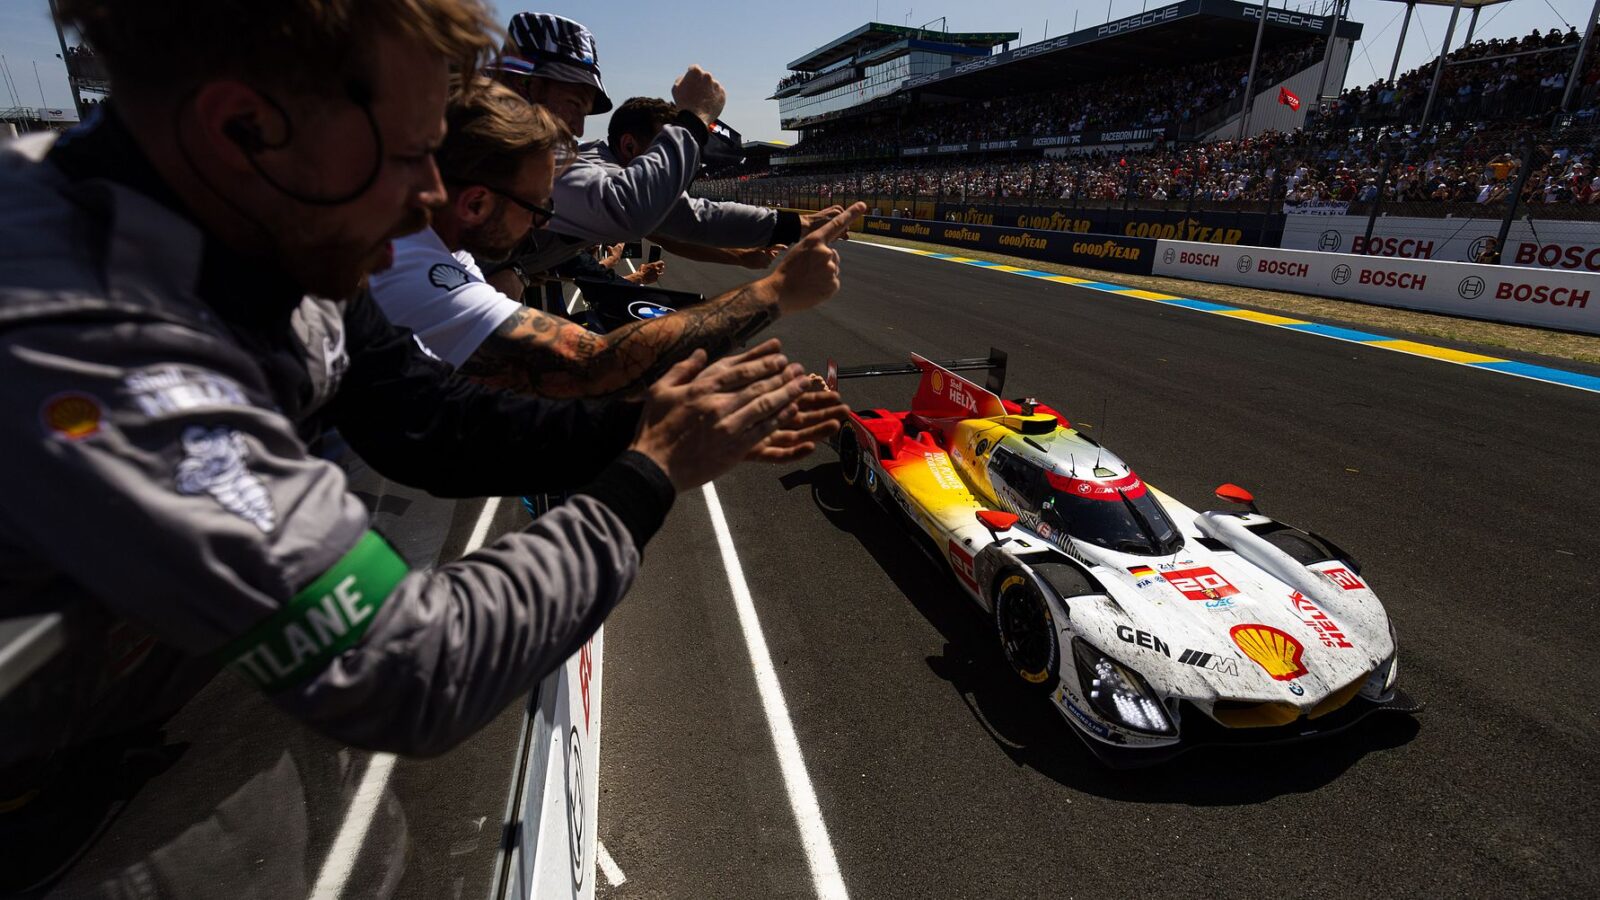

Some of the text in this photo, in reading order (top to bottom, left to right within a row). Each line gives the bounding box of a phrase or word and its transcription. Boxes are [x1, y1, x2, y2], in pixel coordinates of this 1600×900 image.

[1098, 6, 1179, 37] PORSCHE
[1243, 7, 1324, 30] PORSCHE
[1013, 37, 1069, 58] PORSCHE
[955, 57, 997, 74] PORSCHE
[907, 72, 940, 86] PORSCHE
[1032, 137, 1057, 147] RACEBORN
[1101, 130, 1132, 142] RACEBORN
[943, 226, 982, 242] GOODYEAR
[998, 231, 1048, 250] GOODYEAR
[1124, 217, 1243, 246] GOODYEAR
[1072, 239, 1141, 261] GOODYEAR
[1352, 236, 1434, 259] BOSCH
[1179, 251, 1220, 268] BOSCH
[1257, 260, 1309, 277] BOSCH
[1359, 269, 1427, 291] BOSCH
[1495, 282, 1590, 308] BOSCH
[950, 378, 963, 392] Shell
[949, 388, 978, 414] HELIX
[1136, 579, 1152, 589] FIA
[1169, 573, 1229, 597] 20
[1205, 597, 1235, 608] WEC
[238, 575, 373, 685] TLANE
[1287, 590, 1353, 649] HELIX
[1116, 625, 1171, 658] GEN
